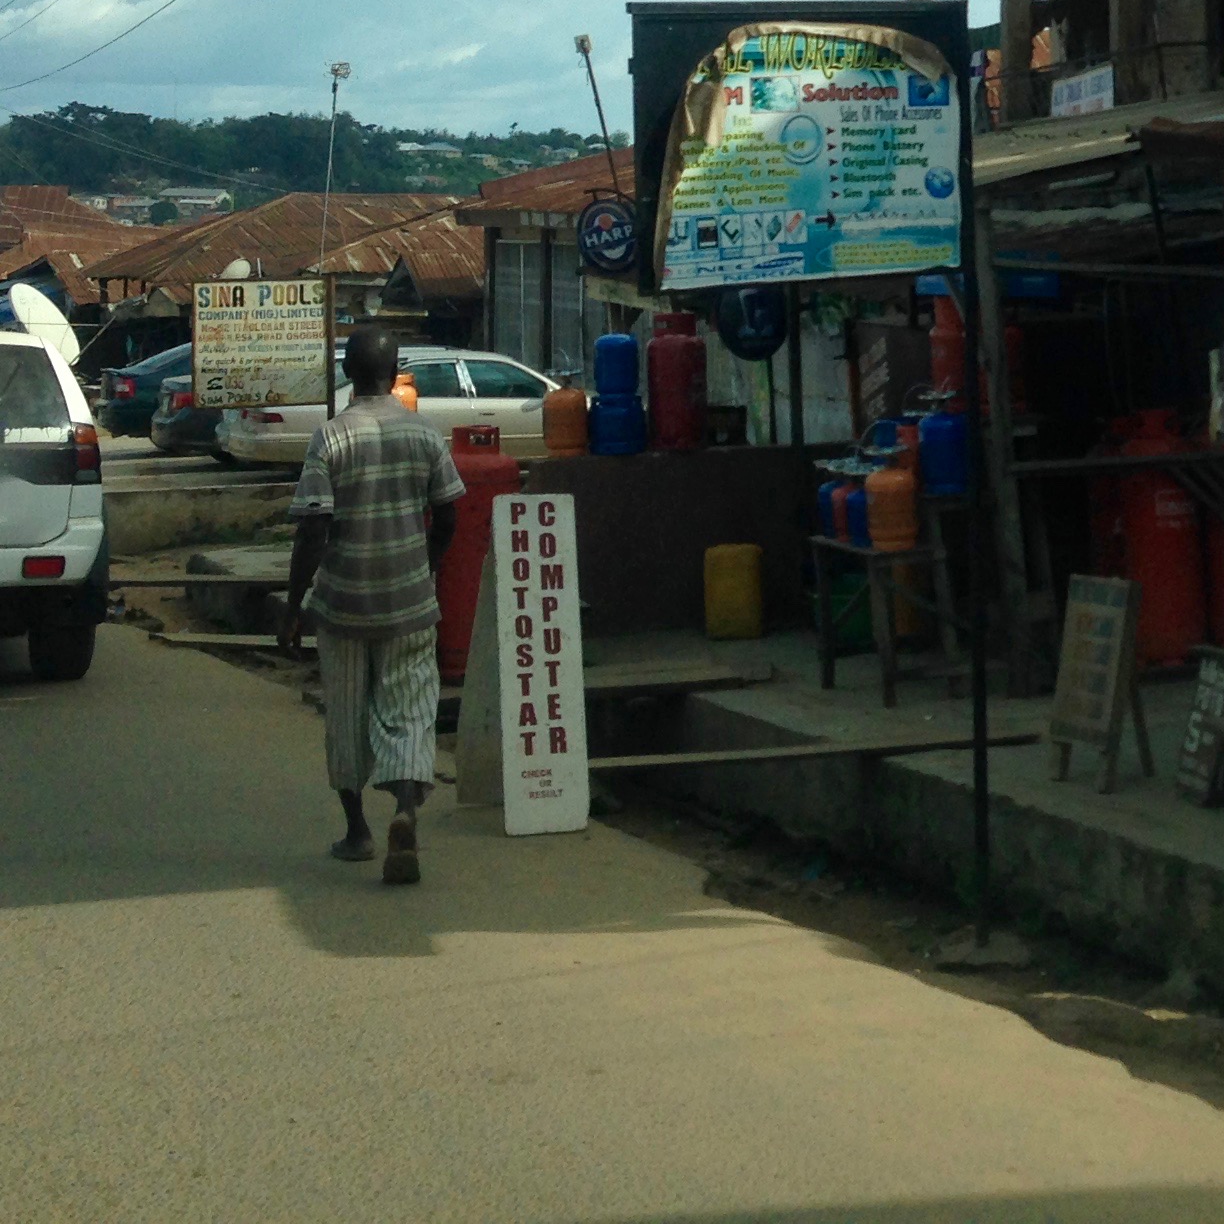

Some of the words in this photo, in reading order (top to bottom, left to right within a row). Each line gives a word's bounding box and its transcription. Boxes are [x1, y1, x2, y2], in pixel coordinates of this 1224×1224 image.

[802, 82, 899, 103] Solution
[874, 105, 898, 122] Phone
[841, 127, 885, 138] Memory
[841, 142, 876, 152] Phone
[842, 157, 886, 170] Original
[893, 156, 928, 168] Casing
[674, 187, 716, 196] Android
[674, 200, 711, 210] Games
[585, 224, 633, 248] HARP
[198, 285, 244, 309] SINA
[257, 283, 325, 307] POOLS
[198, 310, 249, 321] COMPANY
[280, 307, 324, 319] LIMITED
[288, 320, 323, 331] STREET
[510, 502, 538, 756] PHOTOSTAT
[537, 501, 568, 754] COMPUTER
[521, 768, 553, 779] CHECK
[528, 789, 563, 800] RESULT
